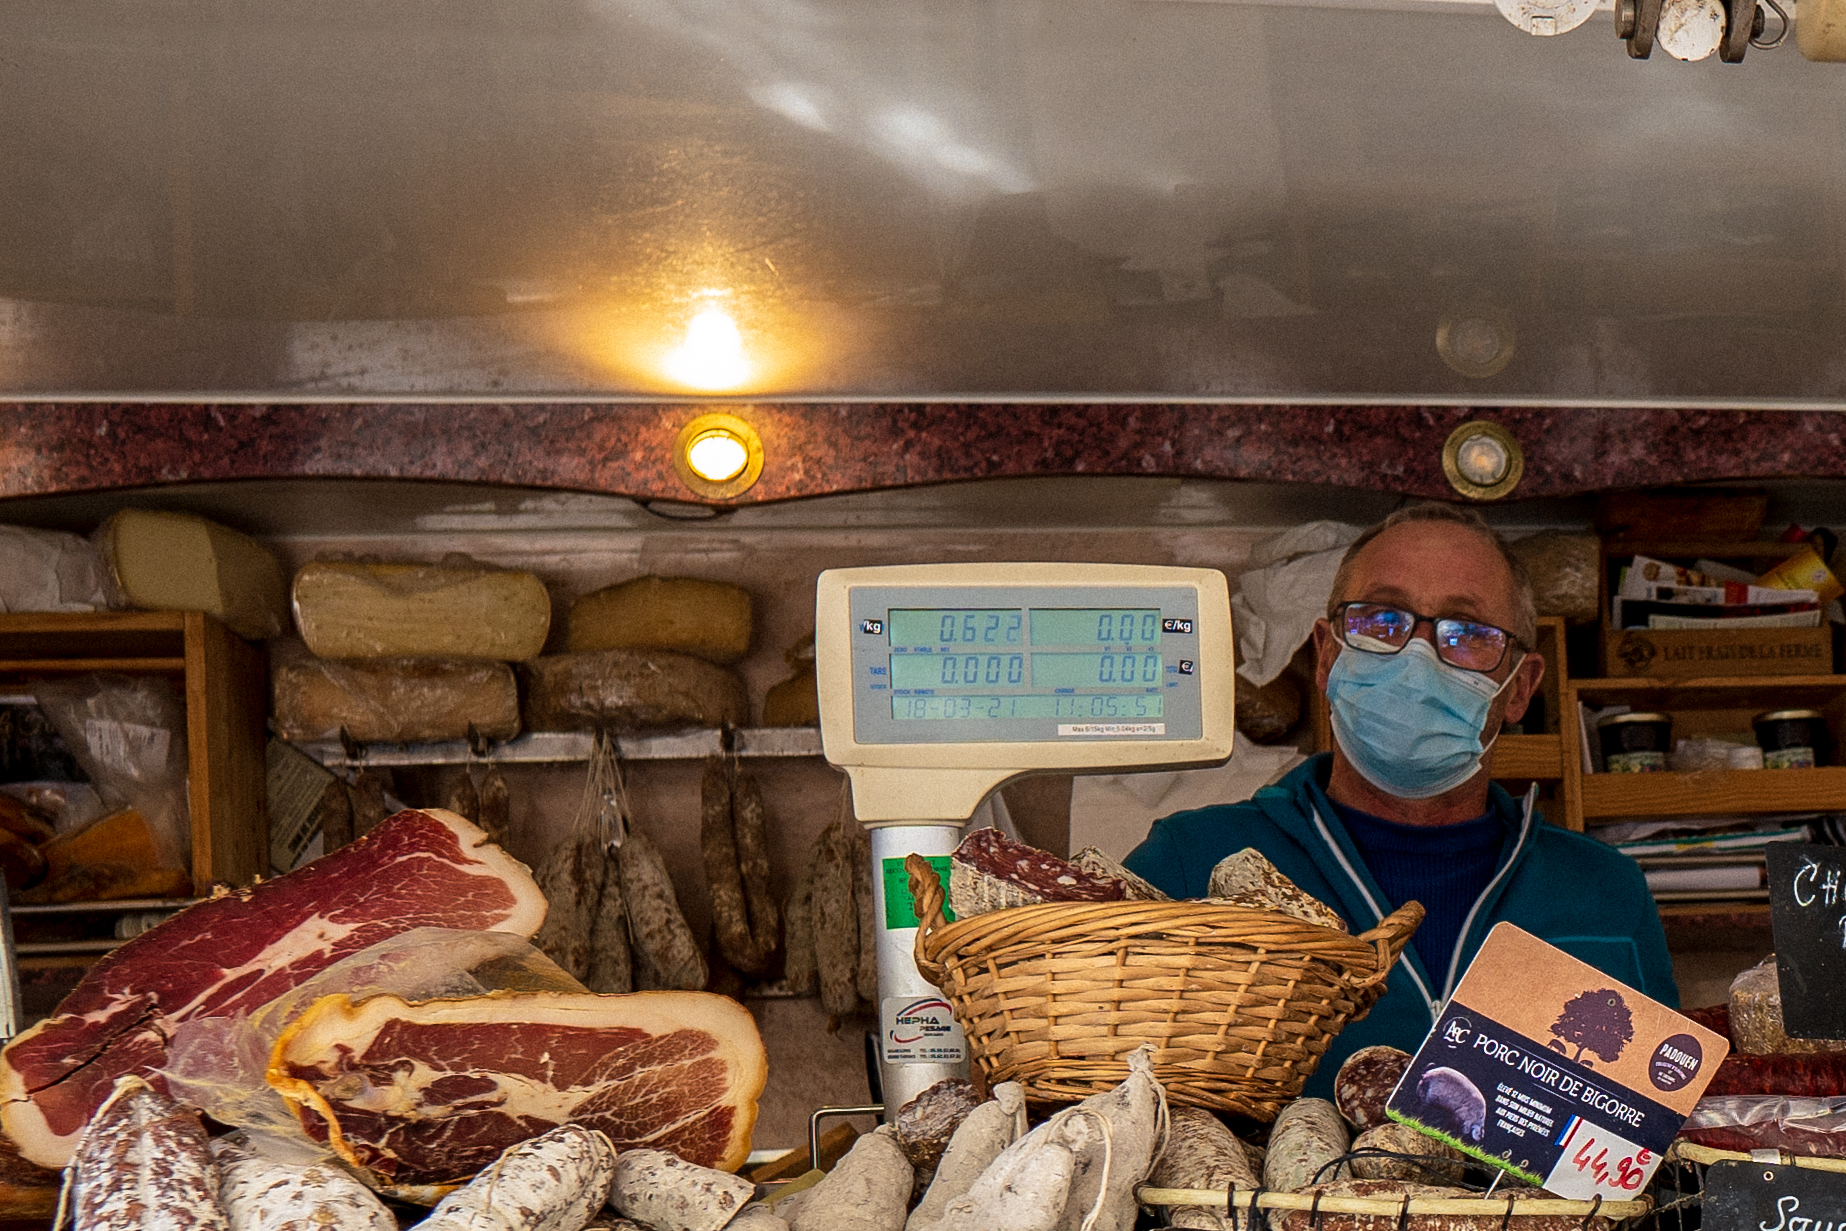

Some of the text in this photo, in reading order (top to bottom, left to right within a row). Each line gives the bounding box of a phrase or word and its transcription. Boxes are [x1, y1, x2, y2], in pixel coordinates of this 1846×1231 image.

[1164, 620, 1191, 632] €/kg
[896, 1016, 940, 1025] HEPHA
[1659, 1043, 1698, 1070] PADOUEN
[1473, 1033, 1645, 1129] PORC NOIR DE BIGORRE
